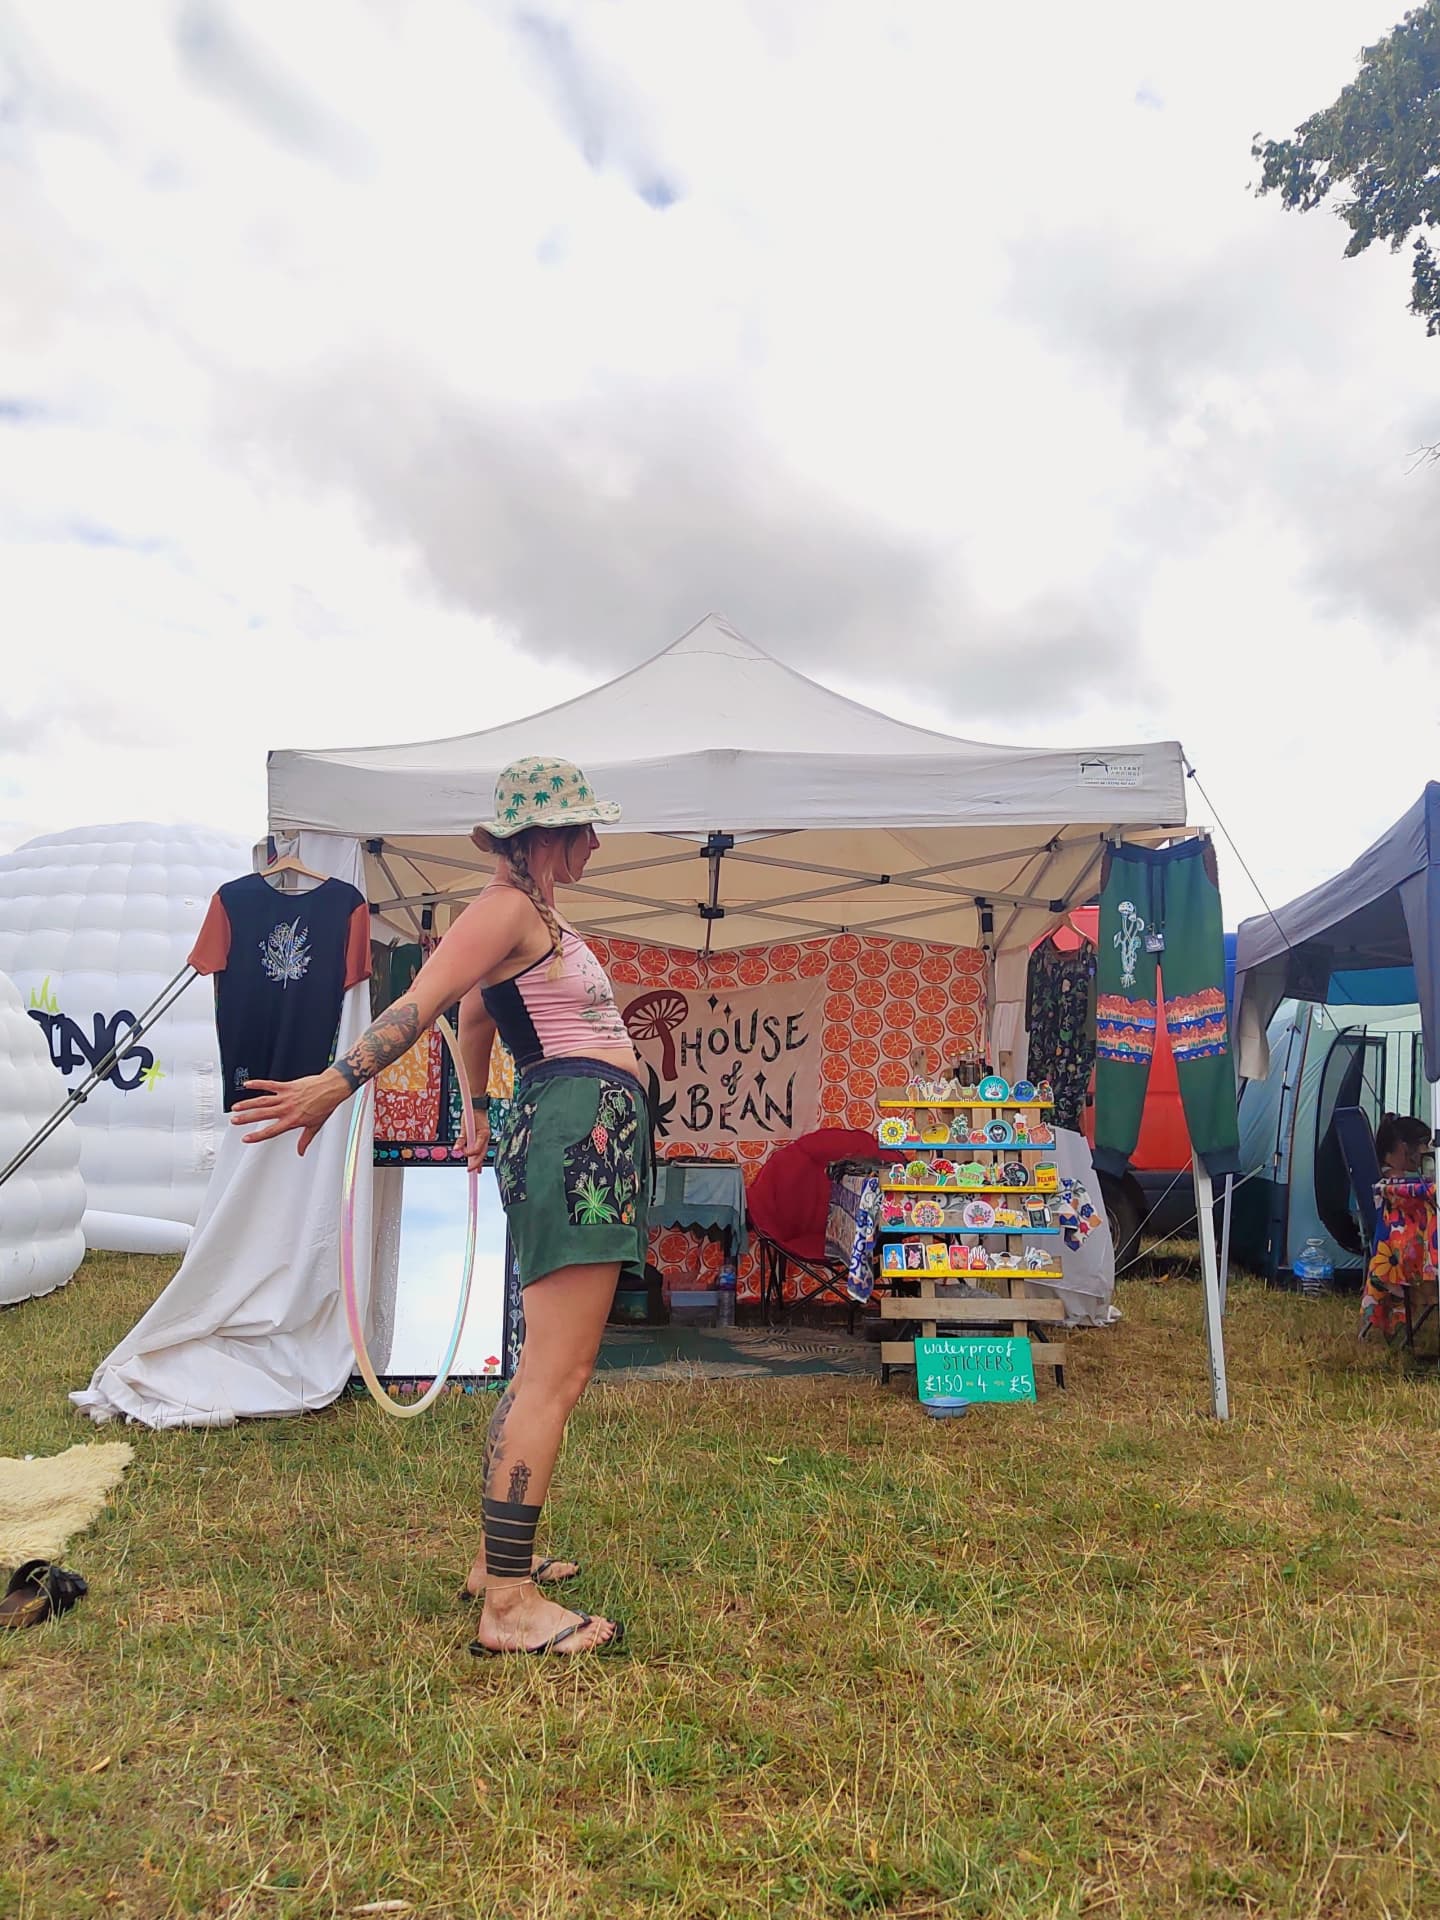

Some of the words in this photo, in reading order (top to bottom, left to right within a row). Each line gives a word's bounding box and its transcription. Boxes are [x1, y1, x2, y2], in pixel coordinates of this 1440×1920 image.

[680, 1008, 809, 1073] HOUSE
[720, 1060, 743, 1096] of
[680, 1071, 797, 1135] BEAN
[923, 1340, 1017, 1358] waterproof
[943, 1355, 1014, 1373] STICKERS
[977, 1374, 989, 1394] 4
[1009, 1374, 1032, 1394] £5
